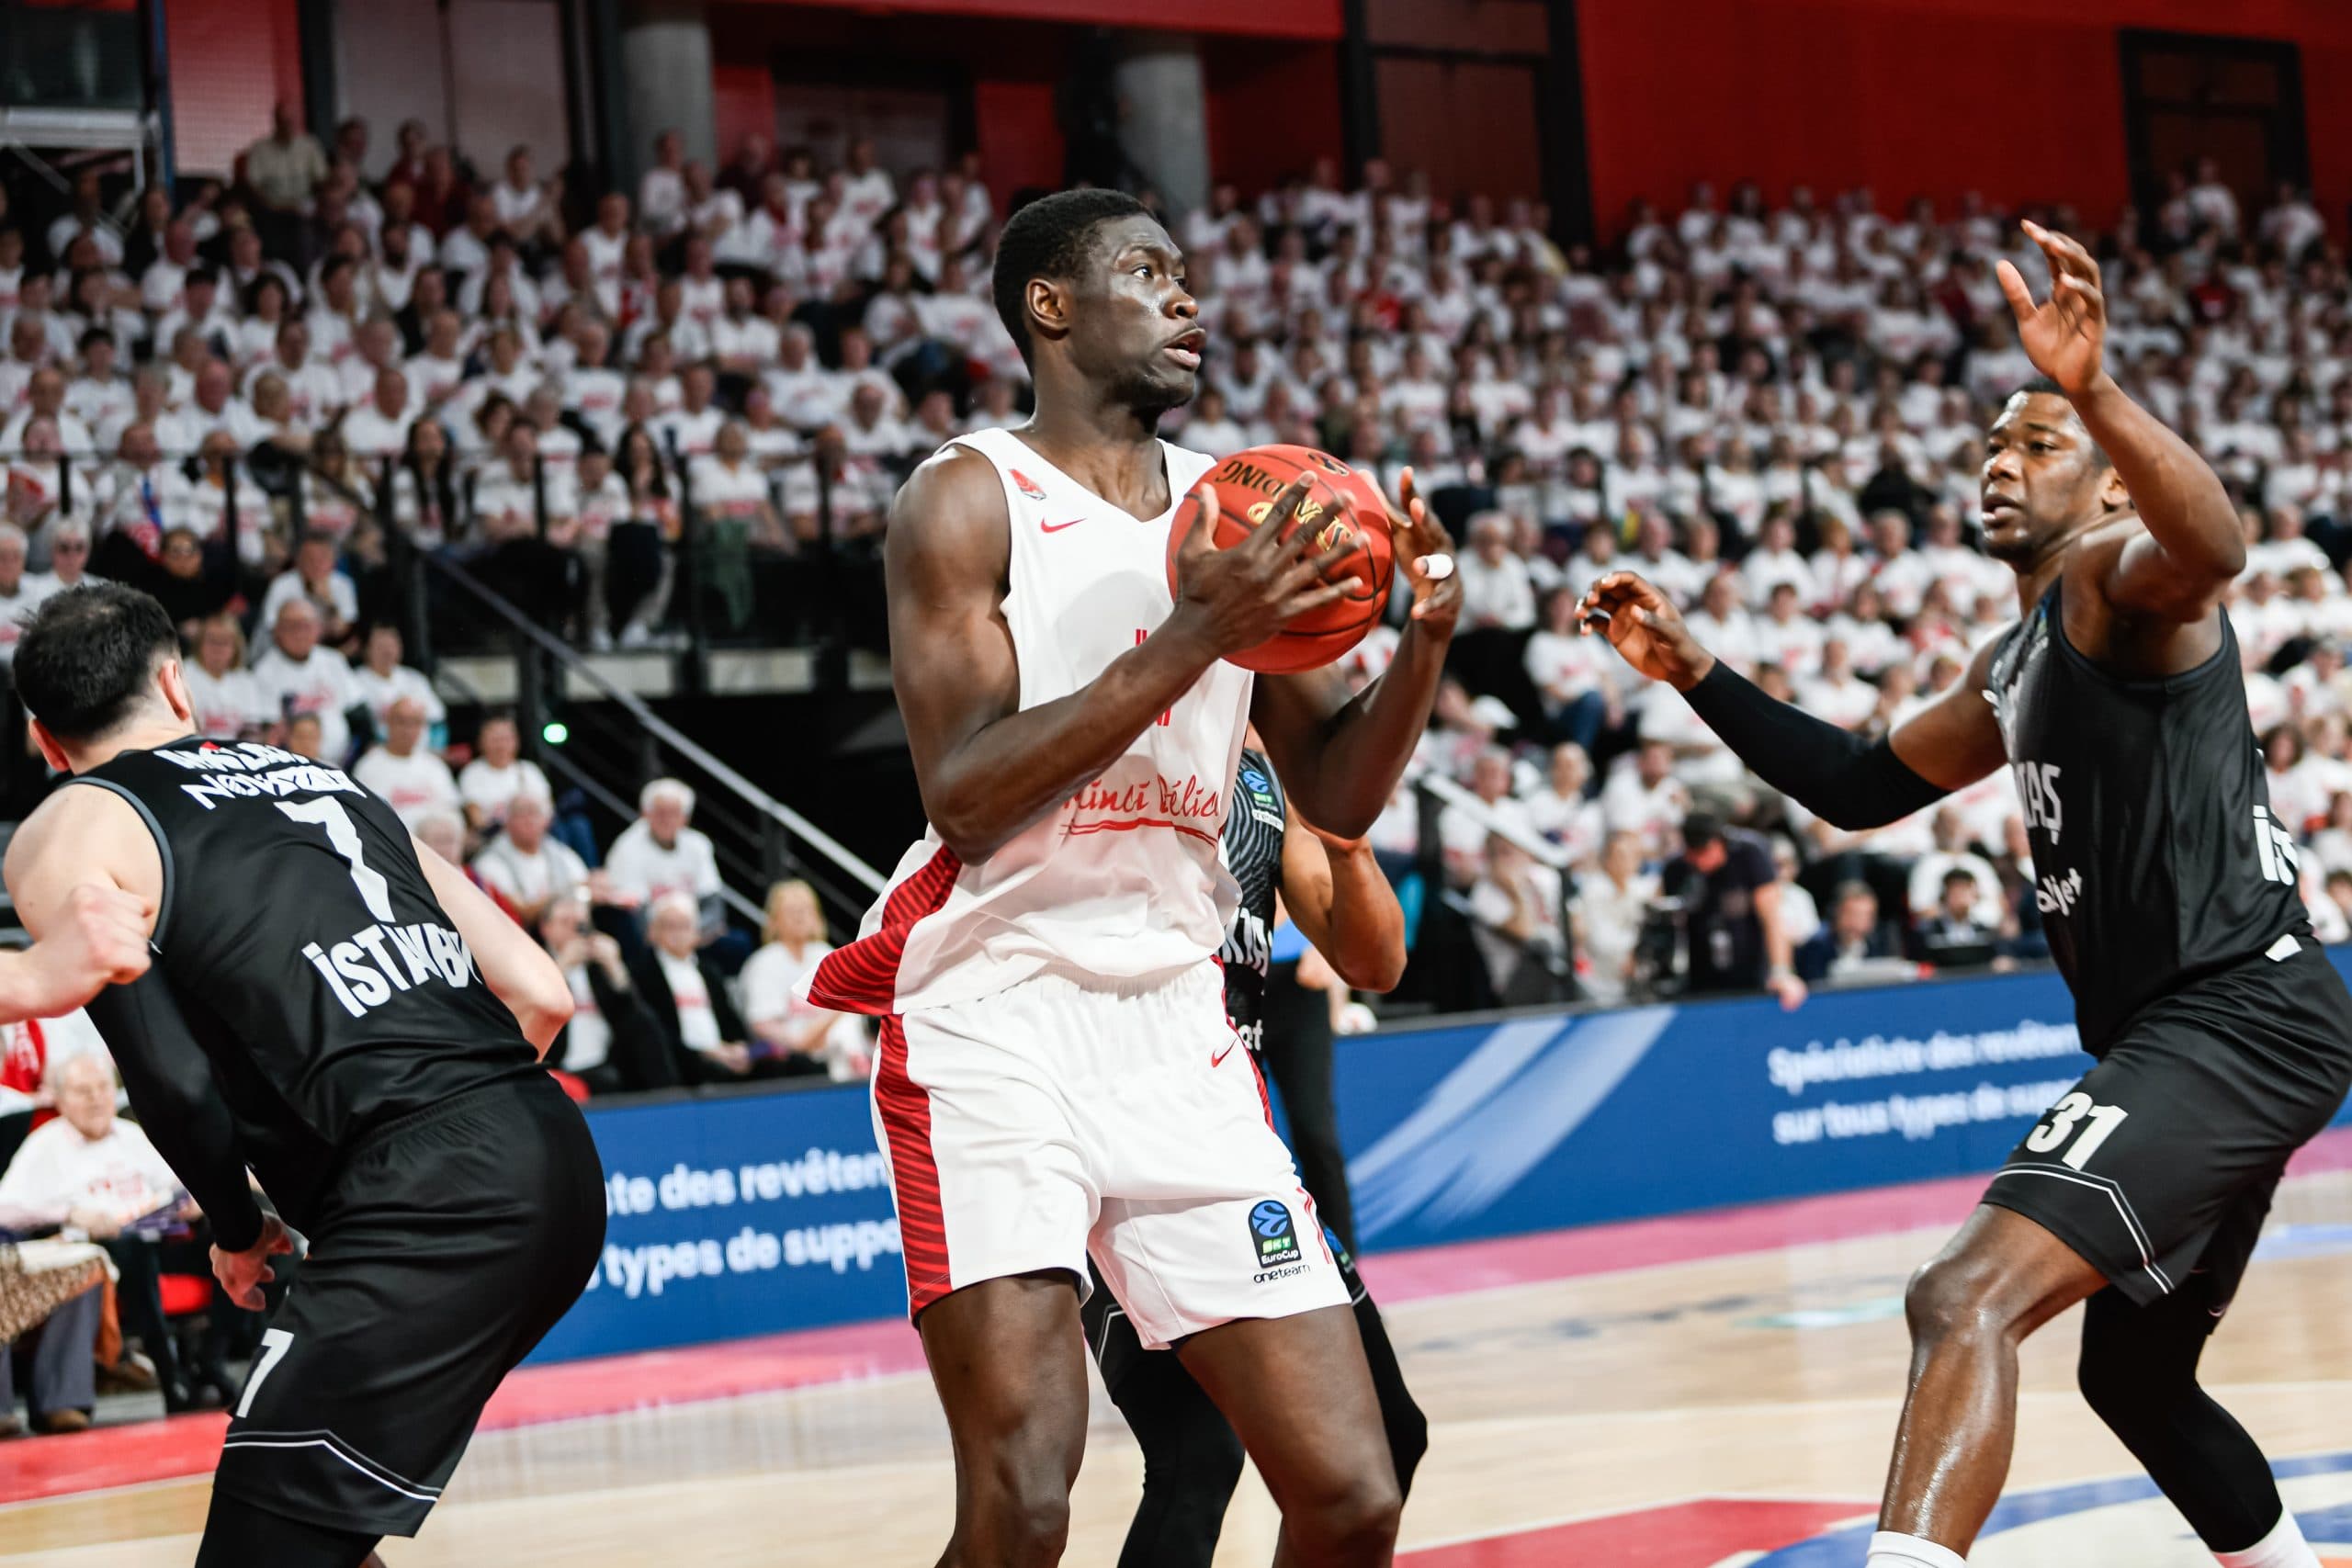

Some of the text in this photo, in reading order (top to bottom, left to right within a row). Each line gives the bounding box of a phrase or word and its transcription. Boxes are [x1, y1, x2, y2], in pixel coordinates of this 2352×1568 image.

[274, 795, 396, 923] 7
[2026, 1092, 2130, 1171] 31
[659, 1163, 735, 1210] des
[603, 1240, 723, 1298] types
[726, 1226, 780, 1272] de
[237, 1328, 294, 1418] 7
